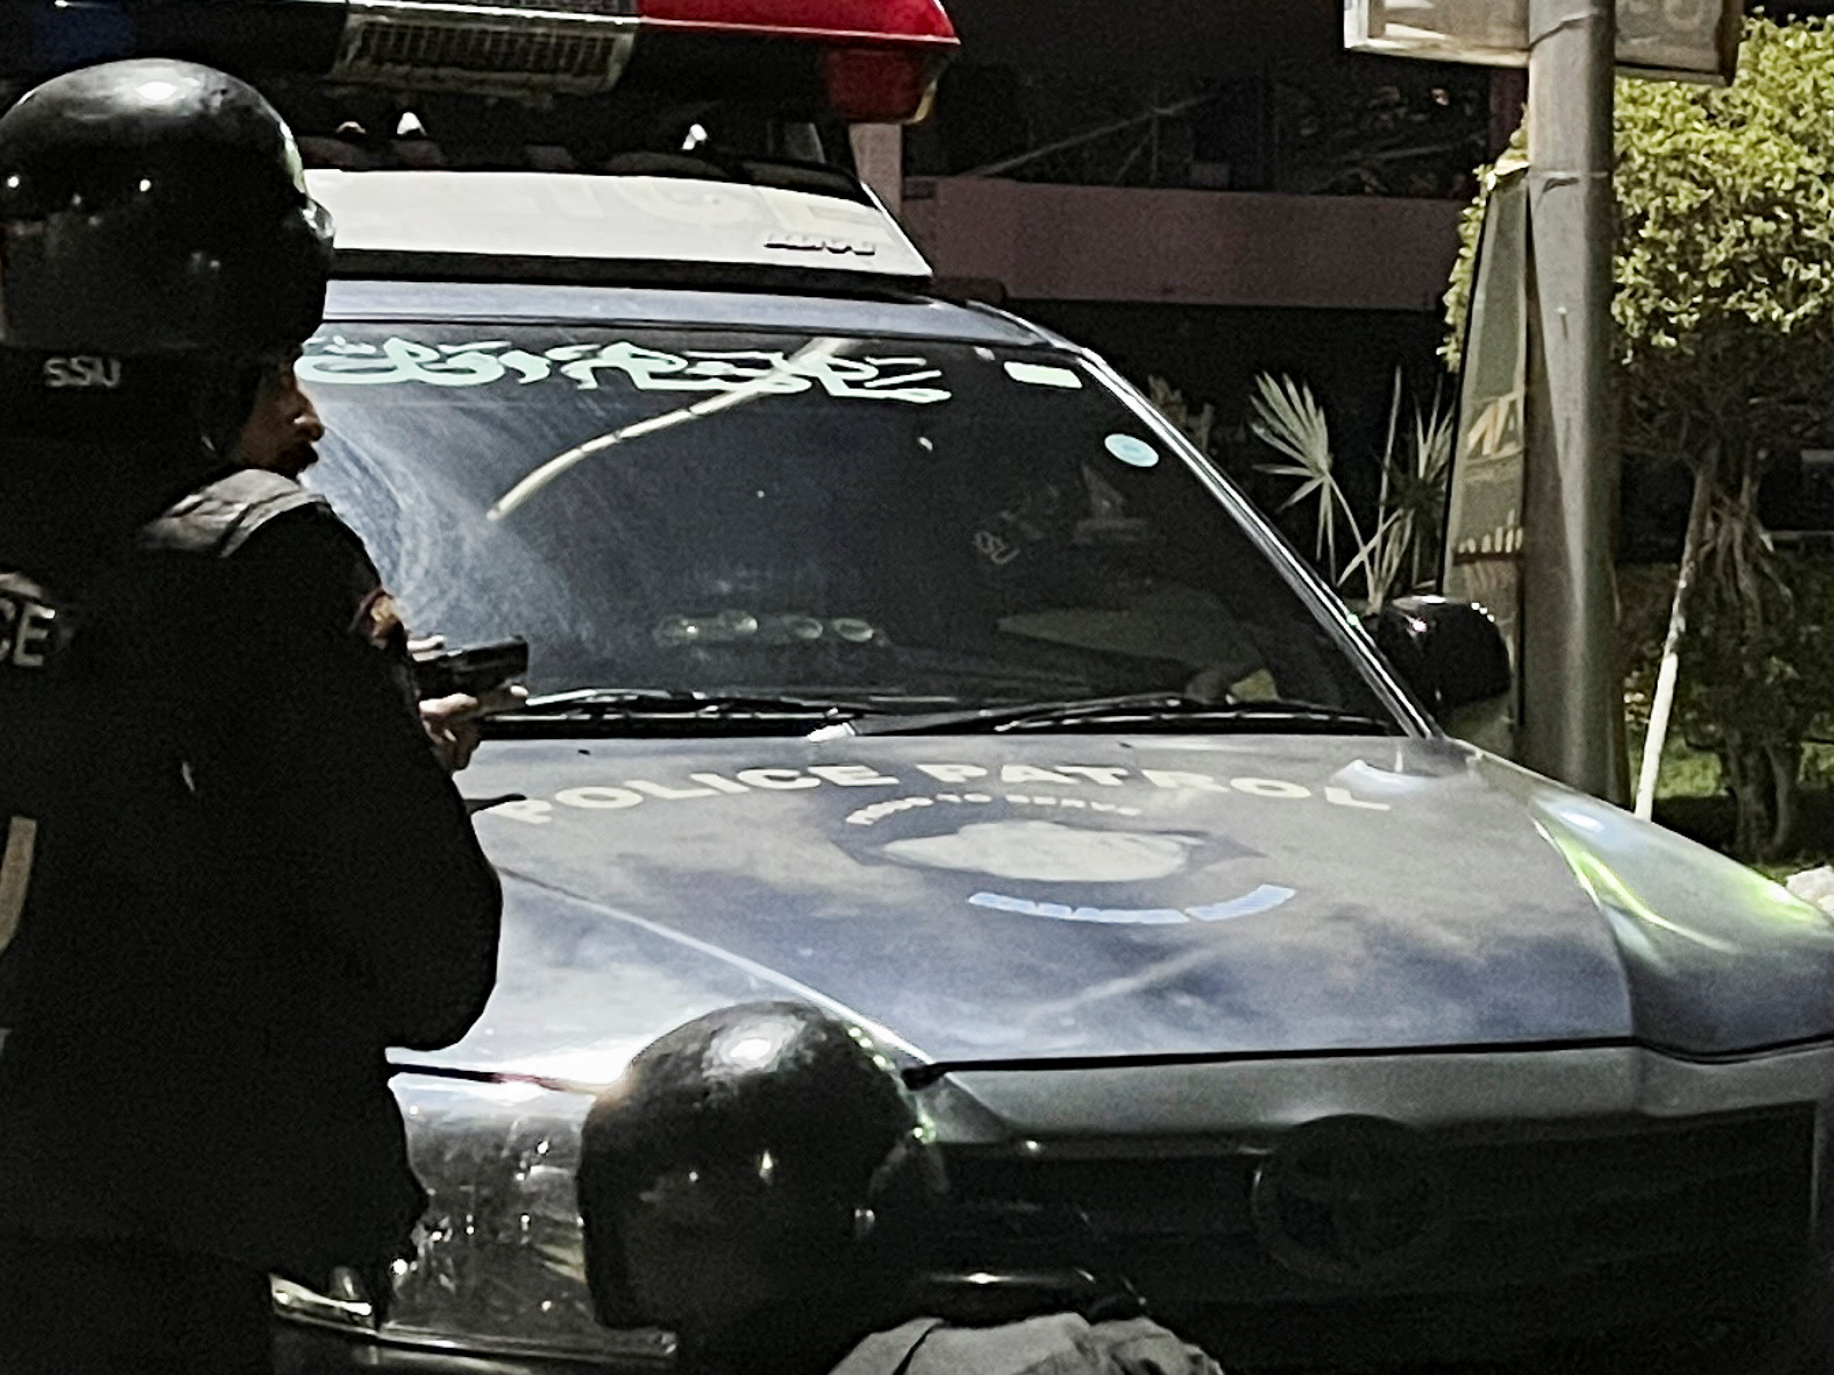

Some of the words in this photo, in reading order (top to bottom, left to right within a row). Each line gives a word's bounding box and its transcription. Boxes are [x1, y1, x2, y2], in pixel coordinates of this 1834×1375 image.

[45, 356, 121, 389] SSU
[487, 763, 898, 826] POLICE
[915, 763, 1392, 813] PATROL
